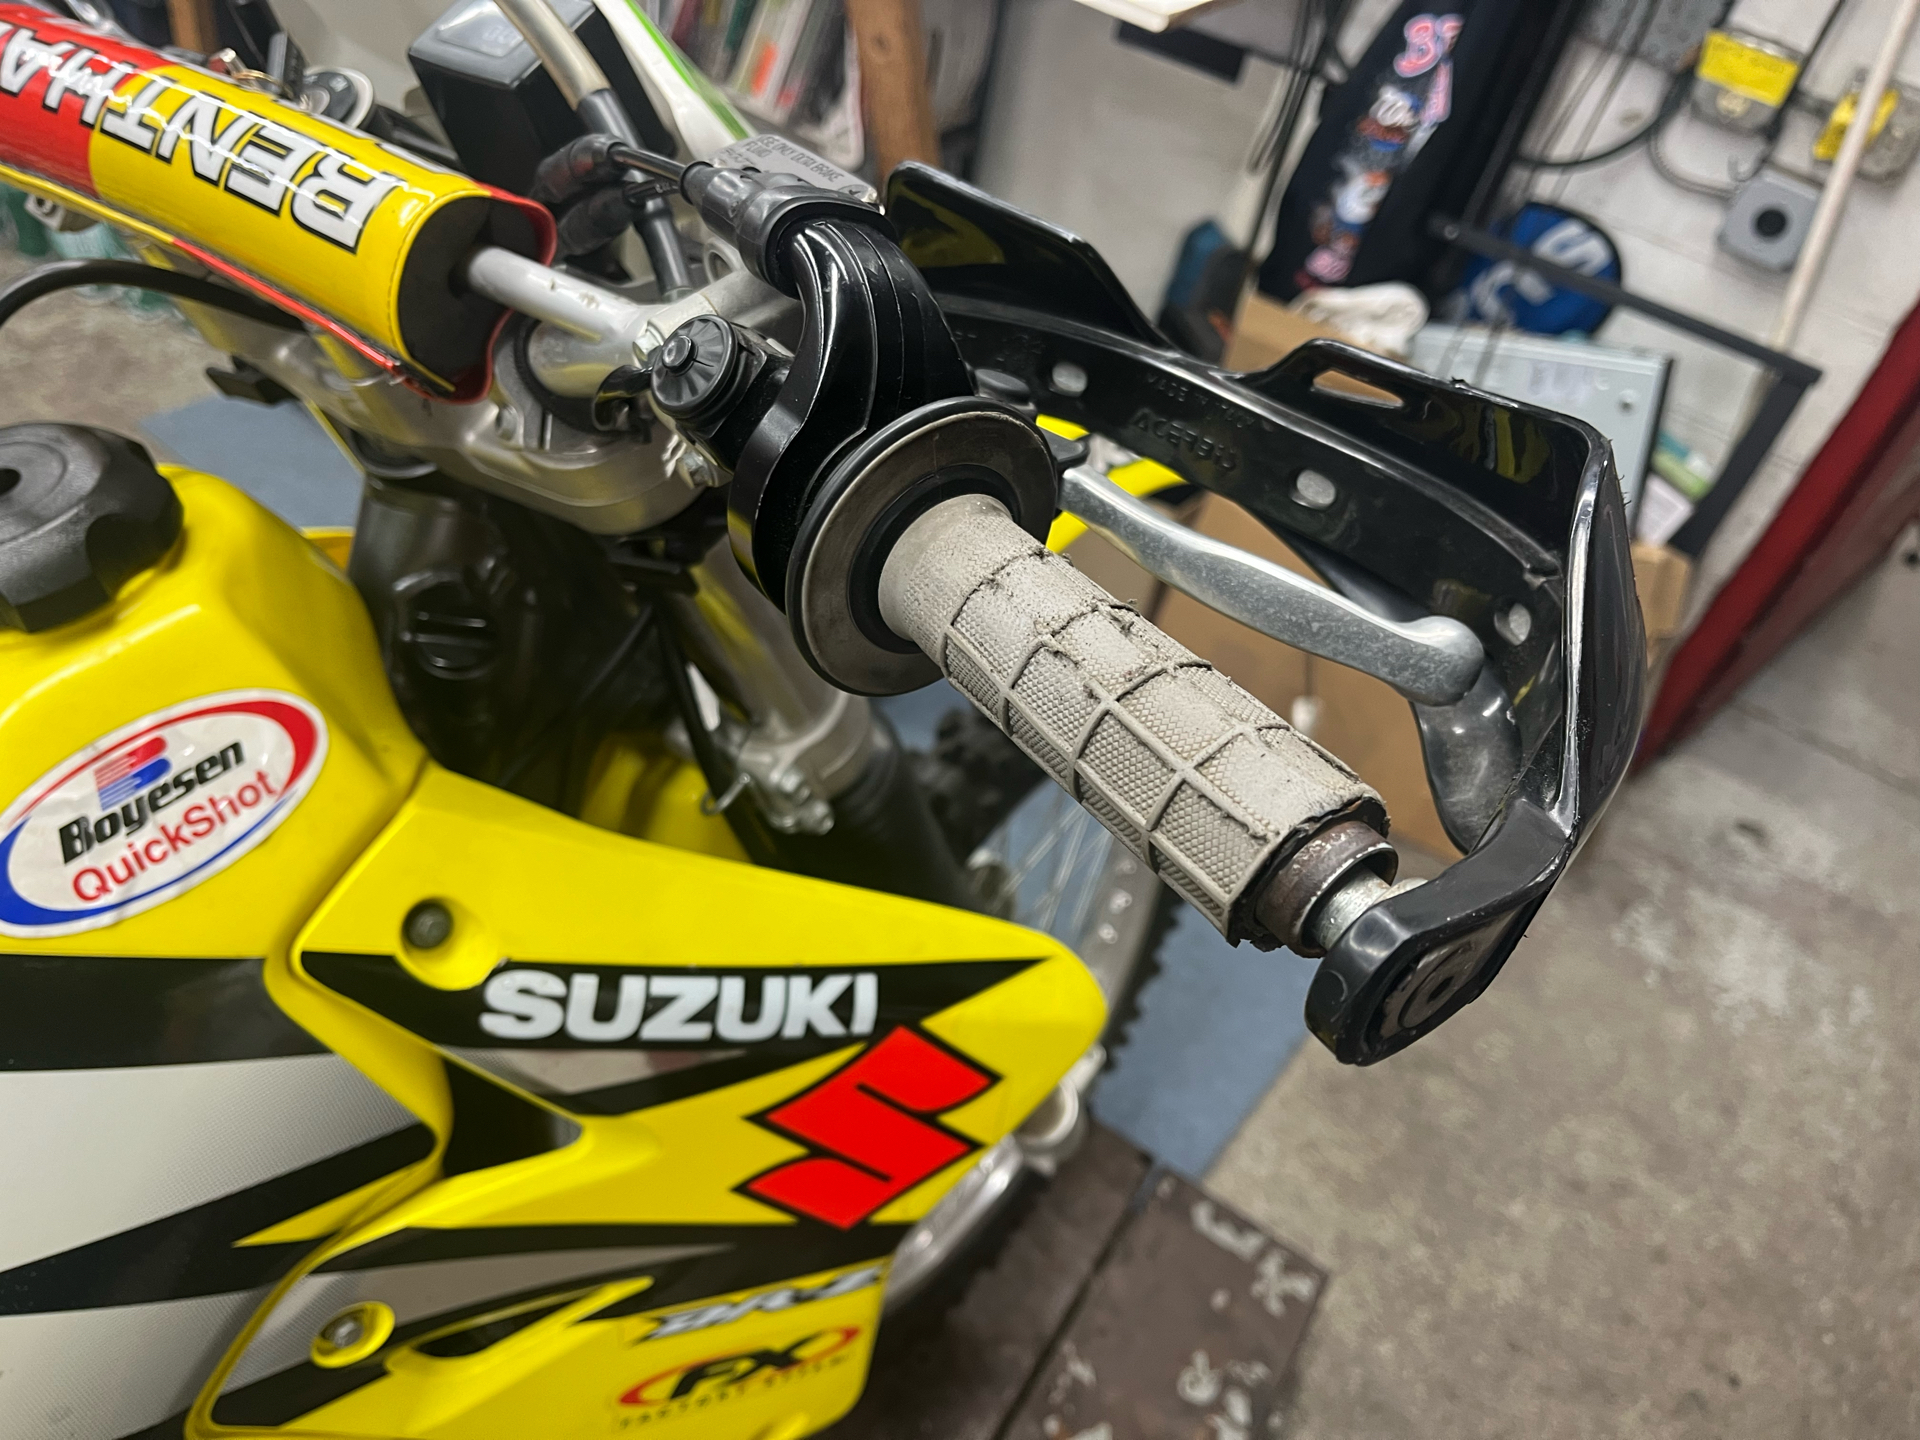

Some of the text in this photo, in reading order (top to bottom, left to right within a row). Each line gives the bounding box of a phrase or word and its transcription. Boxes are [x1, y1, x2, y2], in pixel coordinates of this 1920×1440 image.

[0, 20, 403, 256] RENTHA
[809, 162, 845, 183] BRAKE
[58, 739, 246, 866] Boyesen
[71, 769, 278, 903] QuickShot
[478, 968, 880, 1042] SUZUKI
